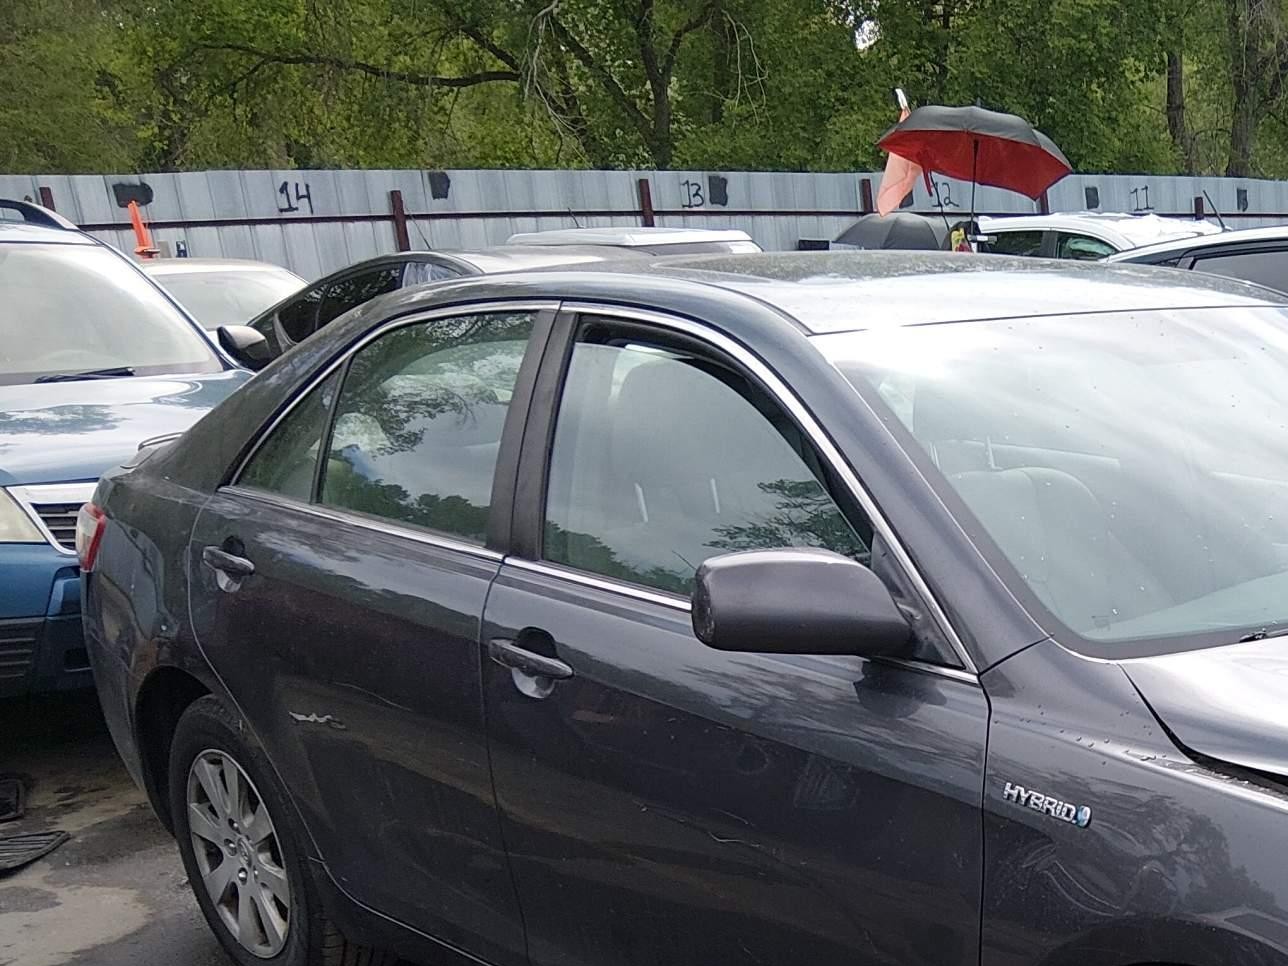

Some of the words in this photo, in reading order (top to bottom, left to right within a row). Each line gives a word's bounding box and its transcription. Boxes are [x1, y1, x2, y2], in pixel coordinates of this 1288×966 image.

[279, 181, 314, 215] 14
[680, 180, 705, 208] 13
[931, 182, 960, 207] 12
[1130, 186, 1154, 211] 11
[1003, 782, 1077, 822] HYBRID
